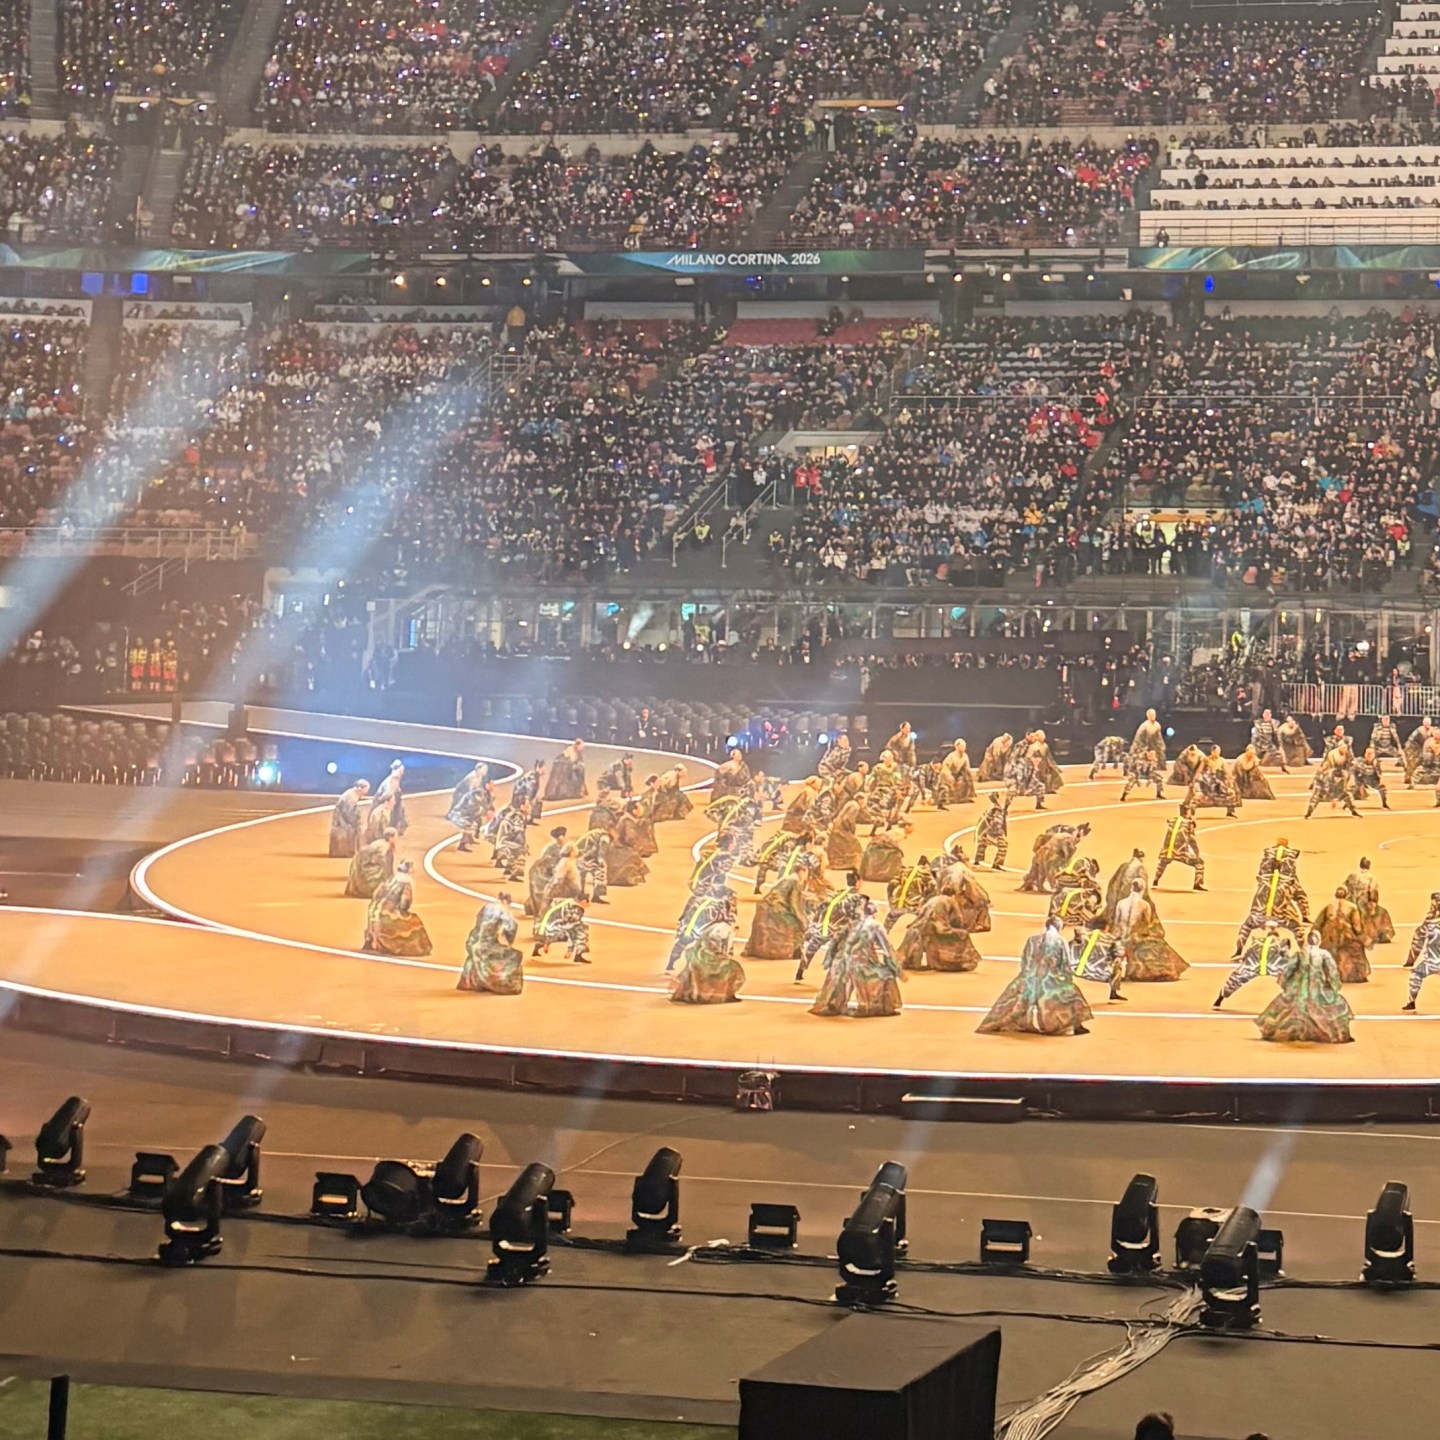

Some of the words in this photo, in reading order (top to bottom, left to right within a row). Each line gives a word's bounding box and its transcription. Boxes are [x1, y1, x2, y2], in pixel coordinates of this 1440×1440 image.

[666, 253, 726, 265] MILANO
[727, 253, 789, 265] CORTINA
[791, 253, 820, 265] 2026
